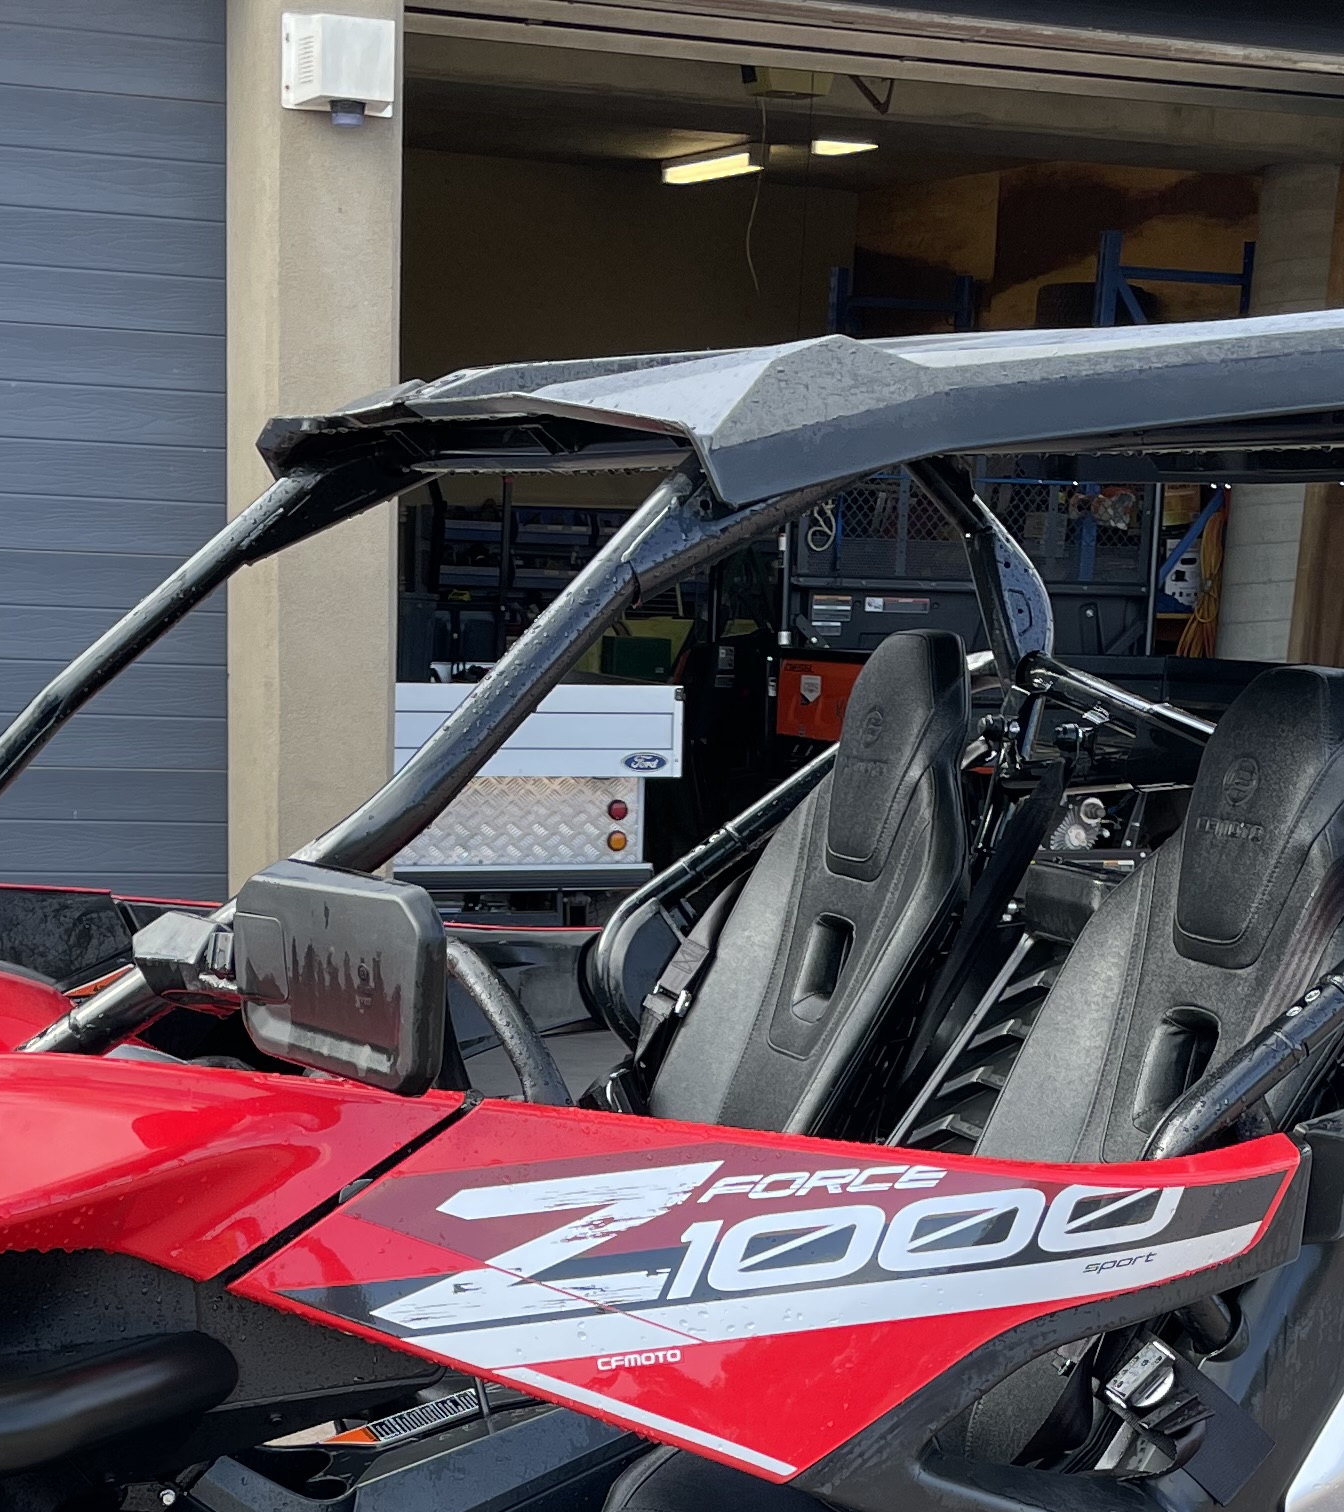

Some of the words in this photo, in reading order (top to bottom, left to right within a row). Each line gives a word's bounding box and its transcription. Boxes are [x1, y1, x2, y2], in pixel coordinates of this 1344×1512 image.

[369, 1160, 725, 1330] Z
[696, 1165, 949, 1204] FORCE
[666, 1185, 1186, 1301] 1000
[1082, 1251, 1157, 1275] sport
[597, 1349, 682, 1371] CFMOTO
